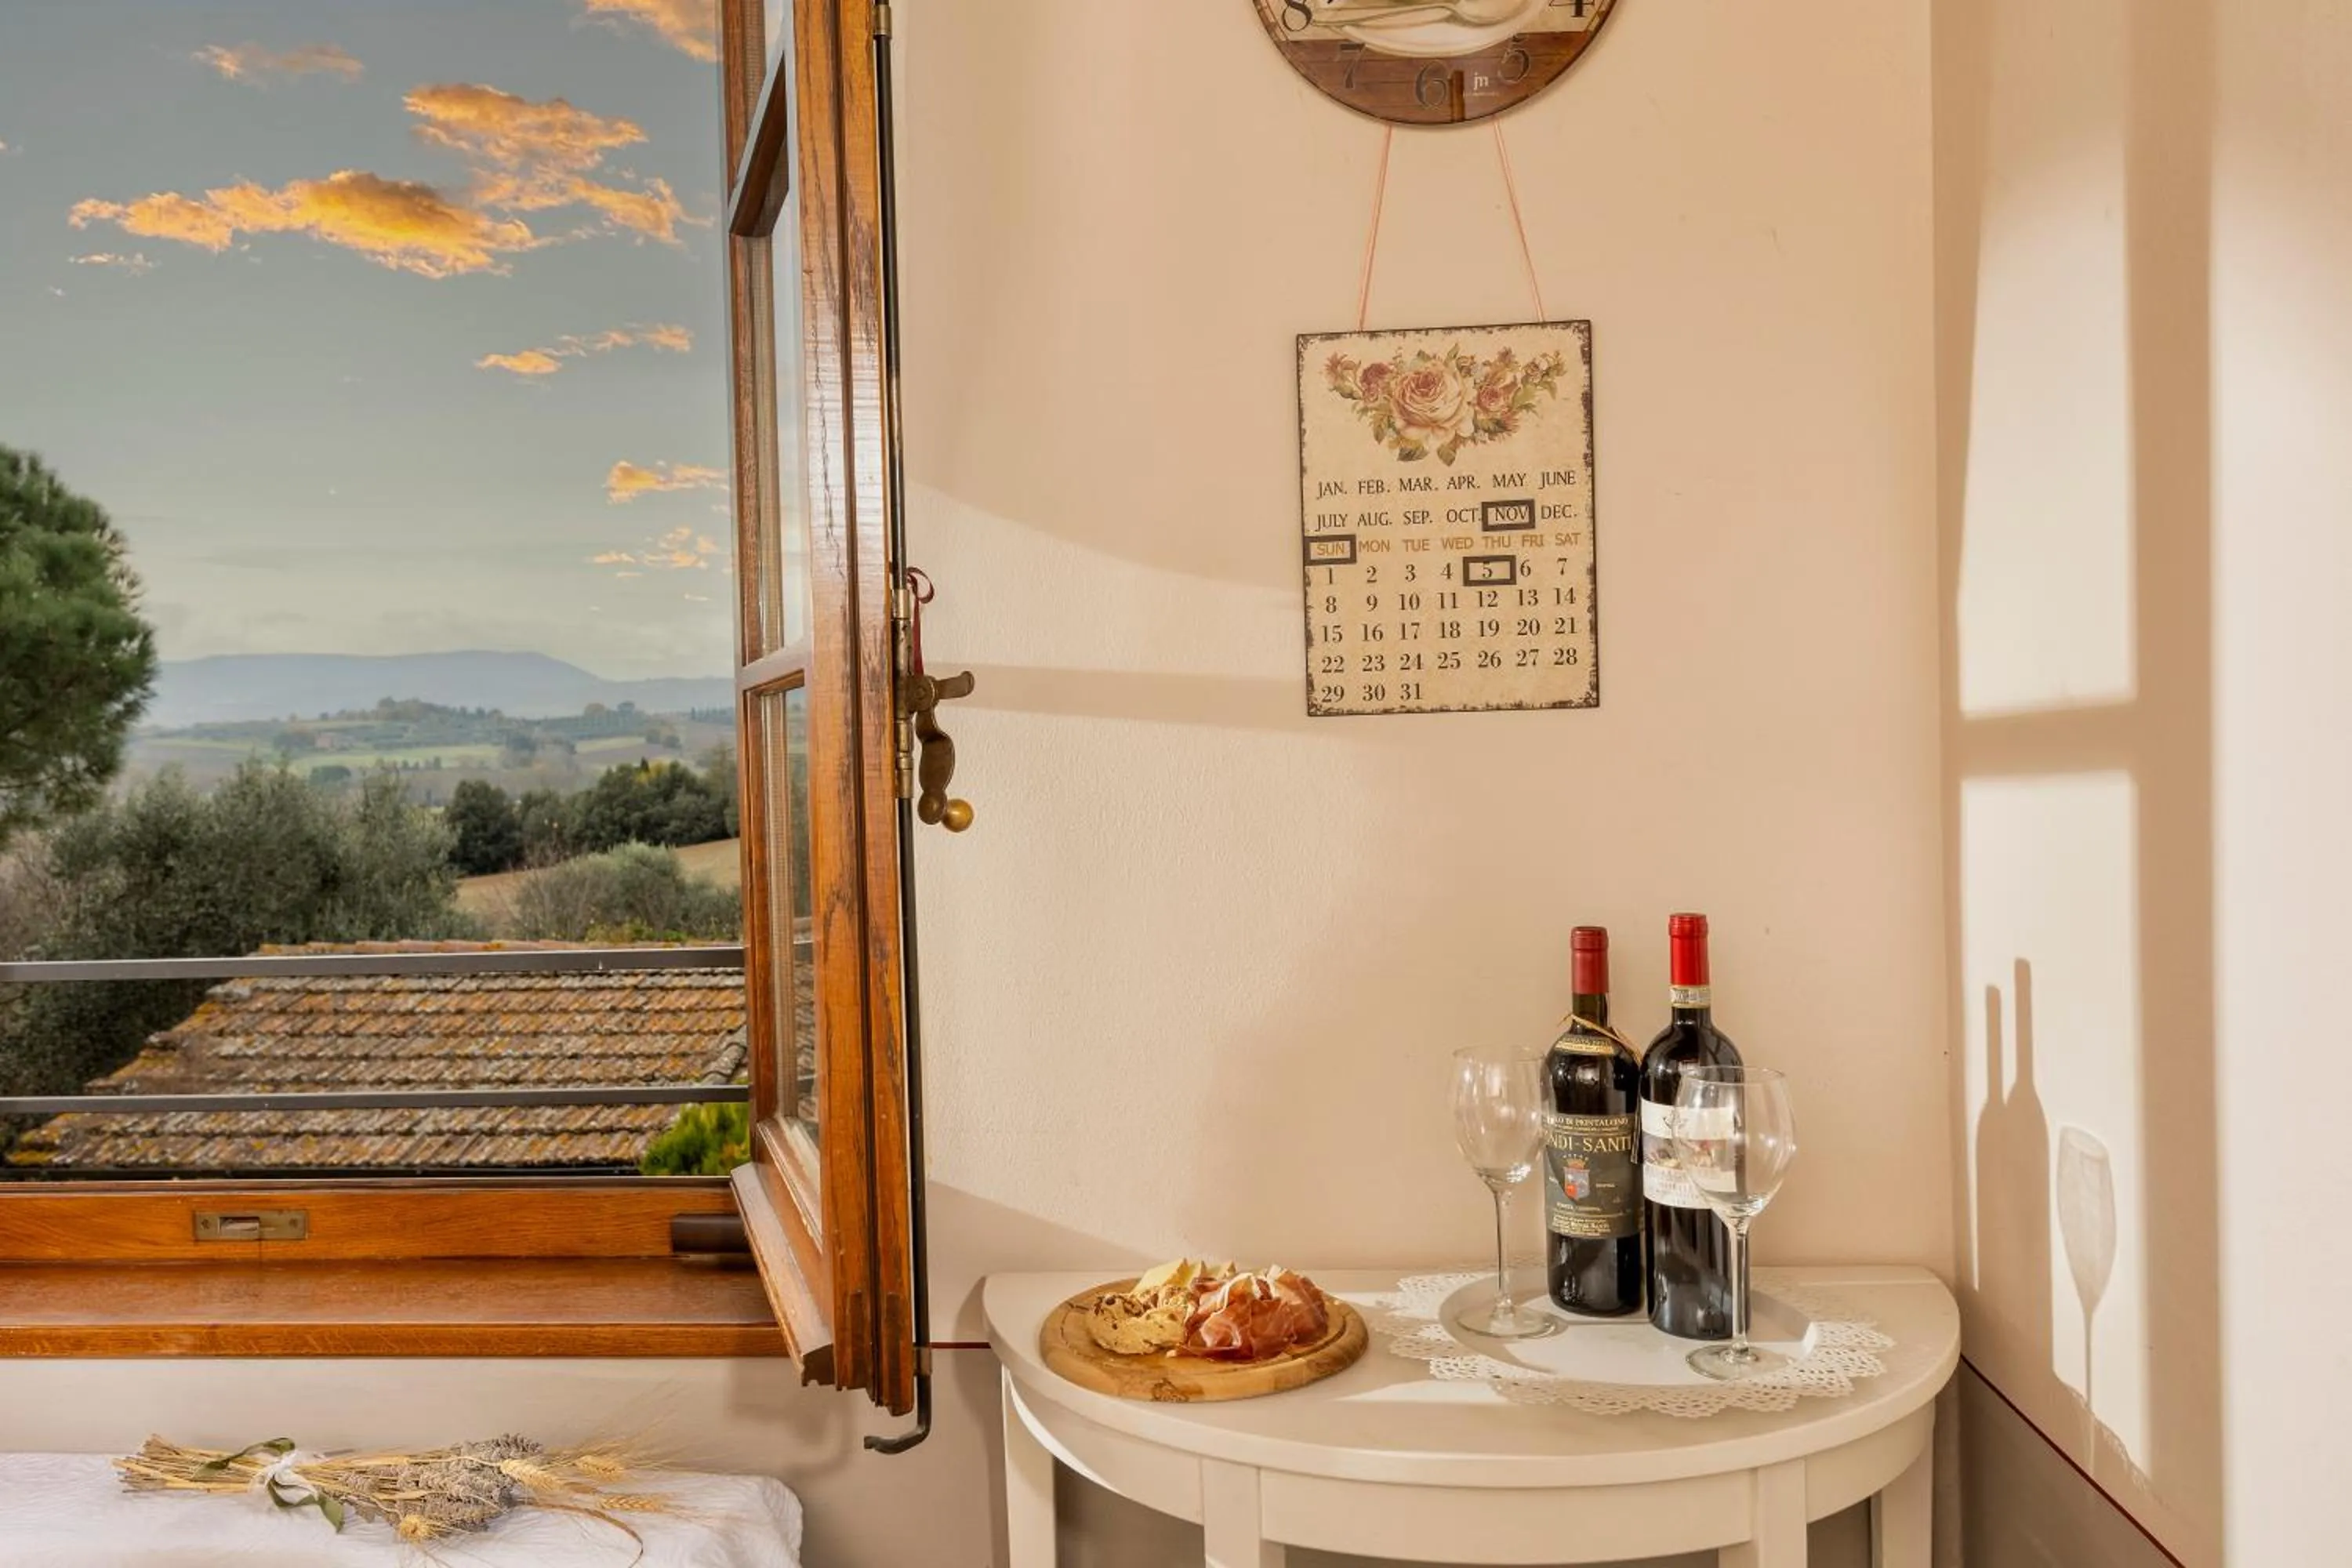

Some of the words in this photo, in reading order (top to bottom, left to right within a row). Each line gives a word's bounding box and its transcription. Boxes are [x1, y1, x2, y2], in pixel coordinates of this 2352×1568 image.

[1336, 42, 1369, 89] 7
[1497, 34, 1532, 84] 5
[1414, 60, 1449, 111] 6
[1316, 481, 1348, 499] JAN.
[1358, 479, 1391, 495] FEB.
[1399, 476, 1439, 492] MAR.
[1446, 474, 1481, 490] APR.
[1492, 473, 1526, 488] MAY
[1537, 470, 1577, 489] JUNE
[1315, 514, 1348, 532] JULY
[1357, 512, 1393, 528] AUG.
[1403, 510, 1433, 525] SEP.
[1446, 507, 1481, 523] OCT.
[1494, 506, 1529, 522] NOV
[1541, 504, 1577, 520] DEC.
[1316, 543, 1345, 556] SUN
[1358, 539, 1391, 553] MON
[1402, 539, 1431, 552] TUE
[1442, 536, 1475, 550] WED
[1481, 535, 1512, 549] THU
[1522, 534, 1545, 548] FRI
[1555, 532, 1581, 546] SAT
[1327, 568, 1334, 585] 1
[1367, 565, 1377, 583] 2
[1405, 564, 1416, 583] 3
[1440, 562, 1453, 580] 4
[1482, 561, 1493, 579] 5
[1520, 559, 1532, 578] 6
[1556, 557, 1568, 576] 7
[1325, 595, 1338, 614] 8
[1366, 593, 1378, 612] 9
[1399, 593, 1421, 611] 10
[1437, 592, 1460, 609] 11
[1477, 590, 1499, 608] 12
[1517, 589, 1539, 606] 13
[1554, 586, 1576, 605] 14
[1322, 625, 1343, 643] 15
[1361, 623, 1384, 642] 16
[1399, 622, 1421, 641] 17
[1439, 620, 1461, 639] 18
[1479, 619, 1501, 637] 19
[1517, 618, 1541, 637] 20
[1554, 616, 1577, 635] 21
[1321, 655, 1345, 673] 22
[1361, 655, 1386, 672] 23
[1399, 652, 1423, 671] 24
[1437, 652, 1461, 669] 25
[1477, 650, 1502, 669] 26
[1515, 648, 1541, 667] 27
[1553, 647, 1578, 666] 28
[1321, 685, 1345, 703] 29
[1361, 683, 1386, 702] 30
[1399, 682, 1423, 701] 31
